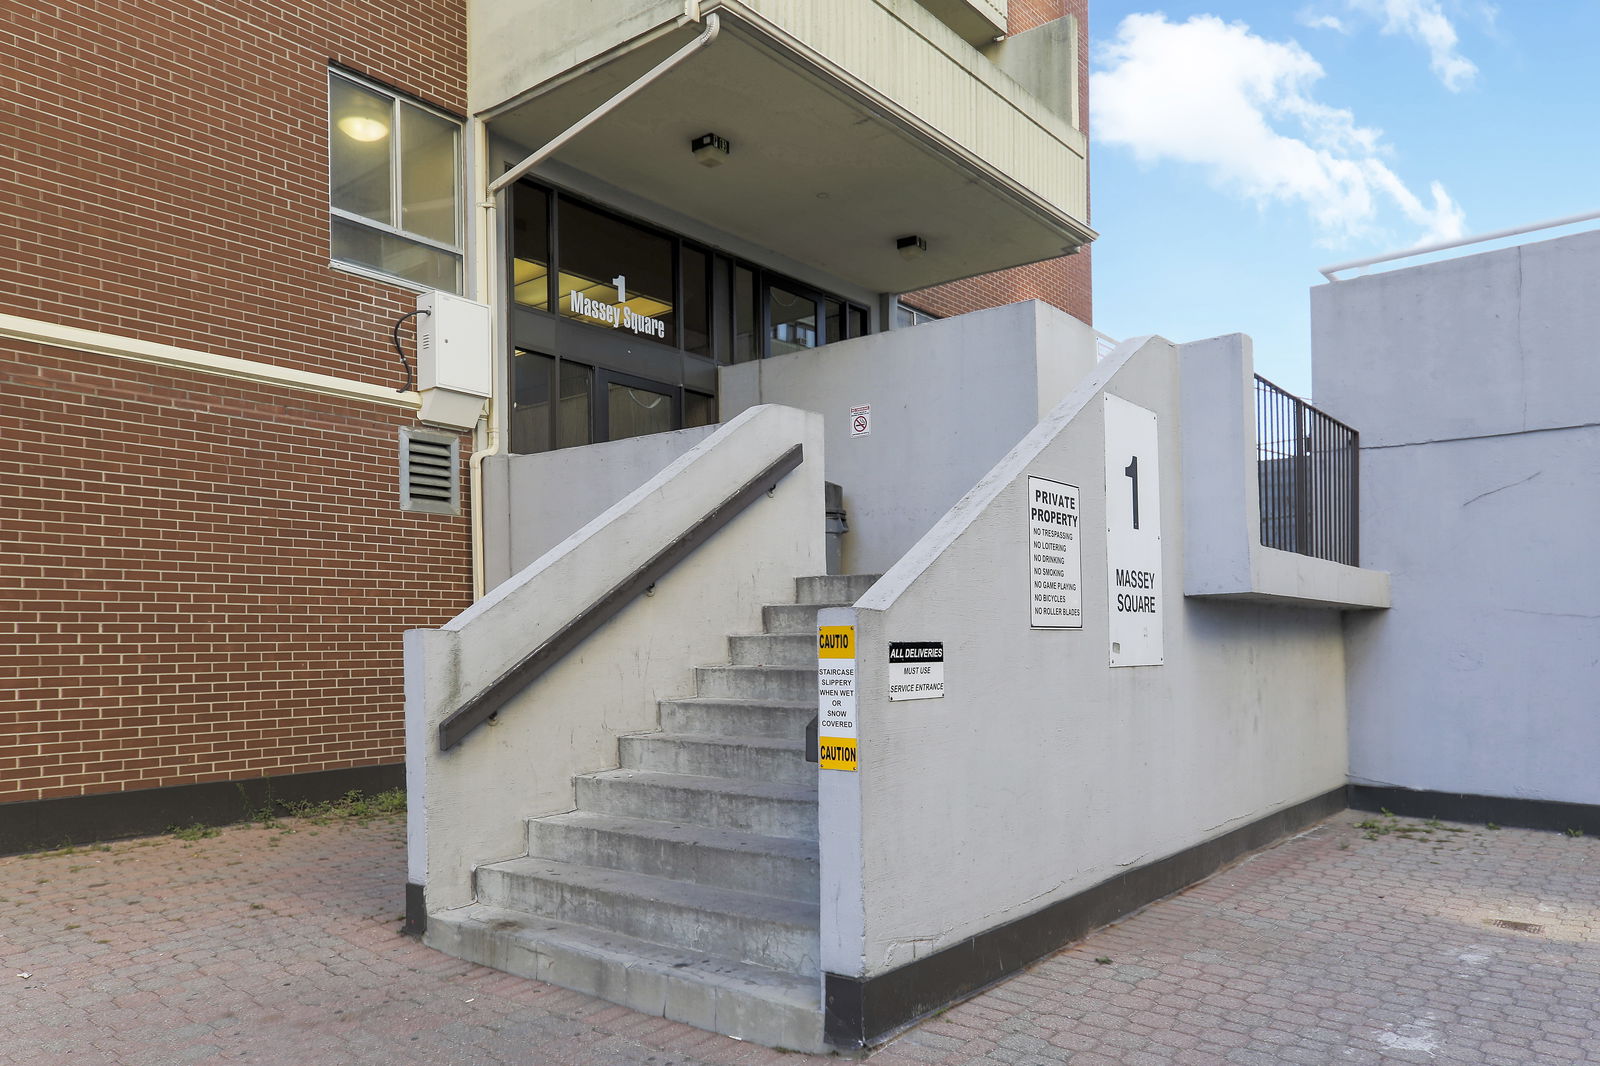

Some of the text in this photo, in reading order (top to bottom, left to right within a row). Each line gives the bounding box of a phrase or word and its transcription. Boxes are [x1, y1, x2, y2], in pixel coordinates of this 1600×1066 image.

[612, 275, 626, 302] 1
[570, 290, 664, 338] Massey Square
[1125, 456, 1139, 530] 1
[1036, 490, 1075, 510] PRIVATE
[1032, 508, 1078, 527] PROPERTY
[1033, 528, 1073, 540] NO TRESPASSING
[1042, 542, 1066, 552] LOITERING
[1042, 555, 1064, 564] DRINKING
[1042, 568, 1064, 577] SMOKING
[1116, 568, 1155, 590] MASSEY
[1043, 581, 1056, 590] GAME
[1058, 582, 1076, 591] PLAYING
[1043, 594, 1066, 602] BICYCLES
[1117, 593, 1156, 614] SQUARE
[1043, 607, 1062, 616] ROLLER
[1063, 608, 1080, 616] BLADES
[819, 634, 849, 648] CAUTIO
[890, 648, 942, 658] ALL DELIVERIES
[890, 682, 944, 693] SERVICE ENTRANCE
[820, 745, 856, 762] CAUTION
